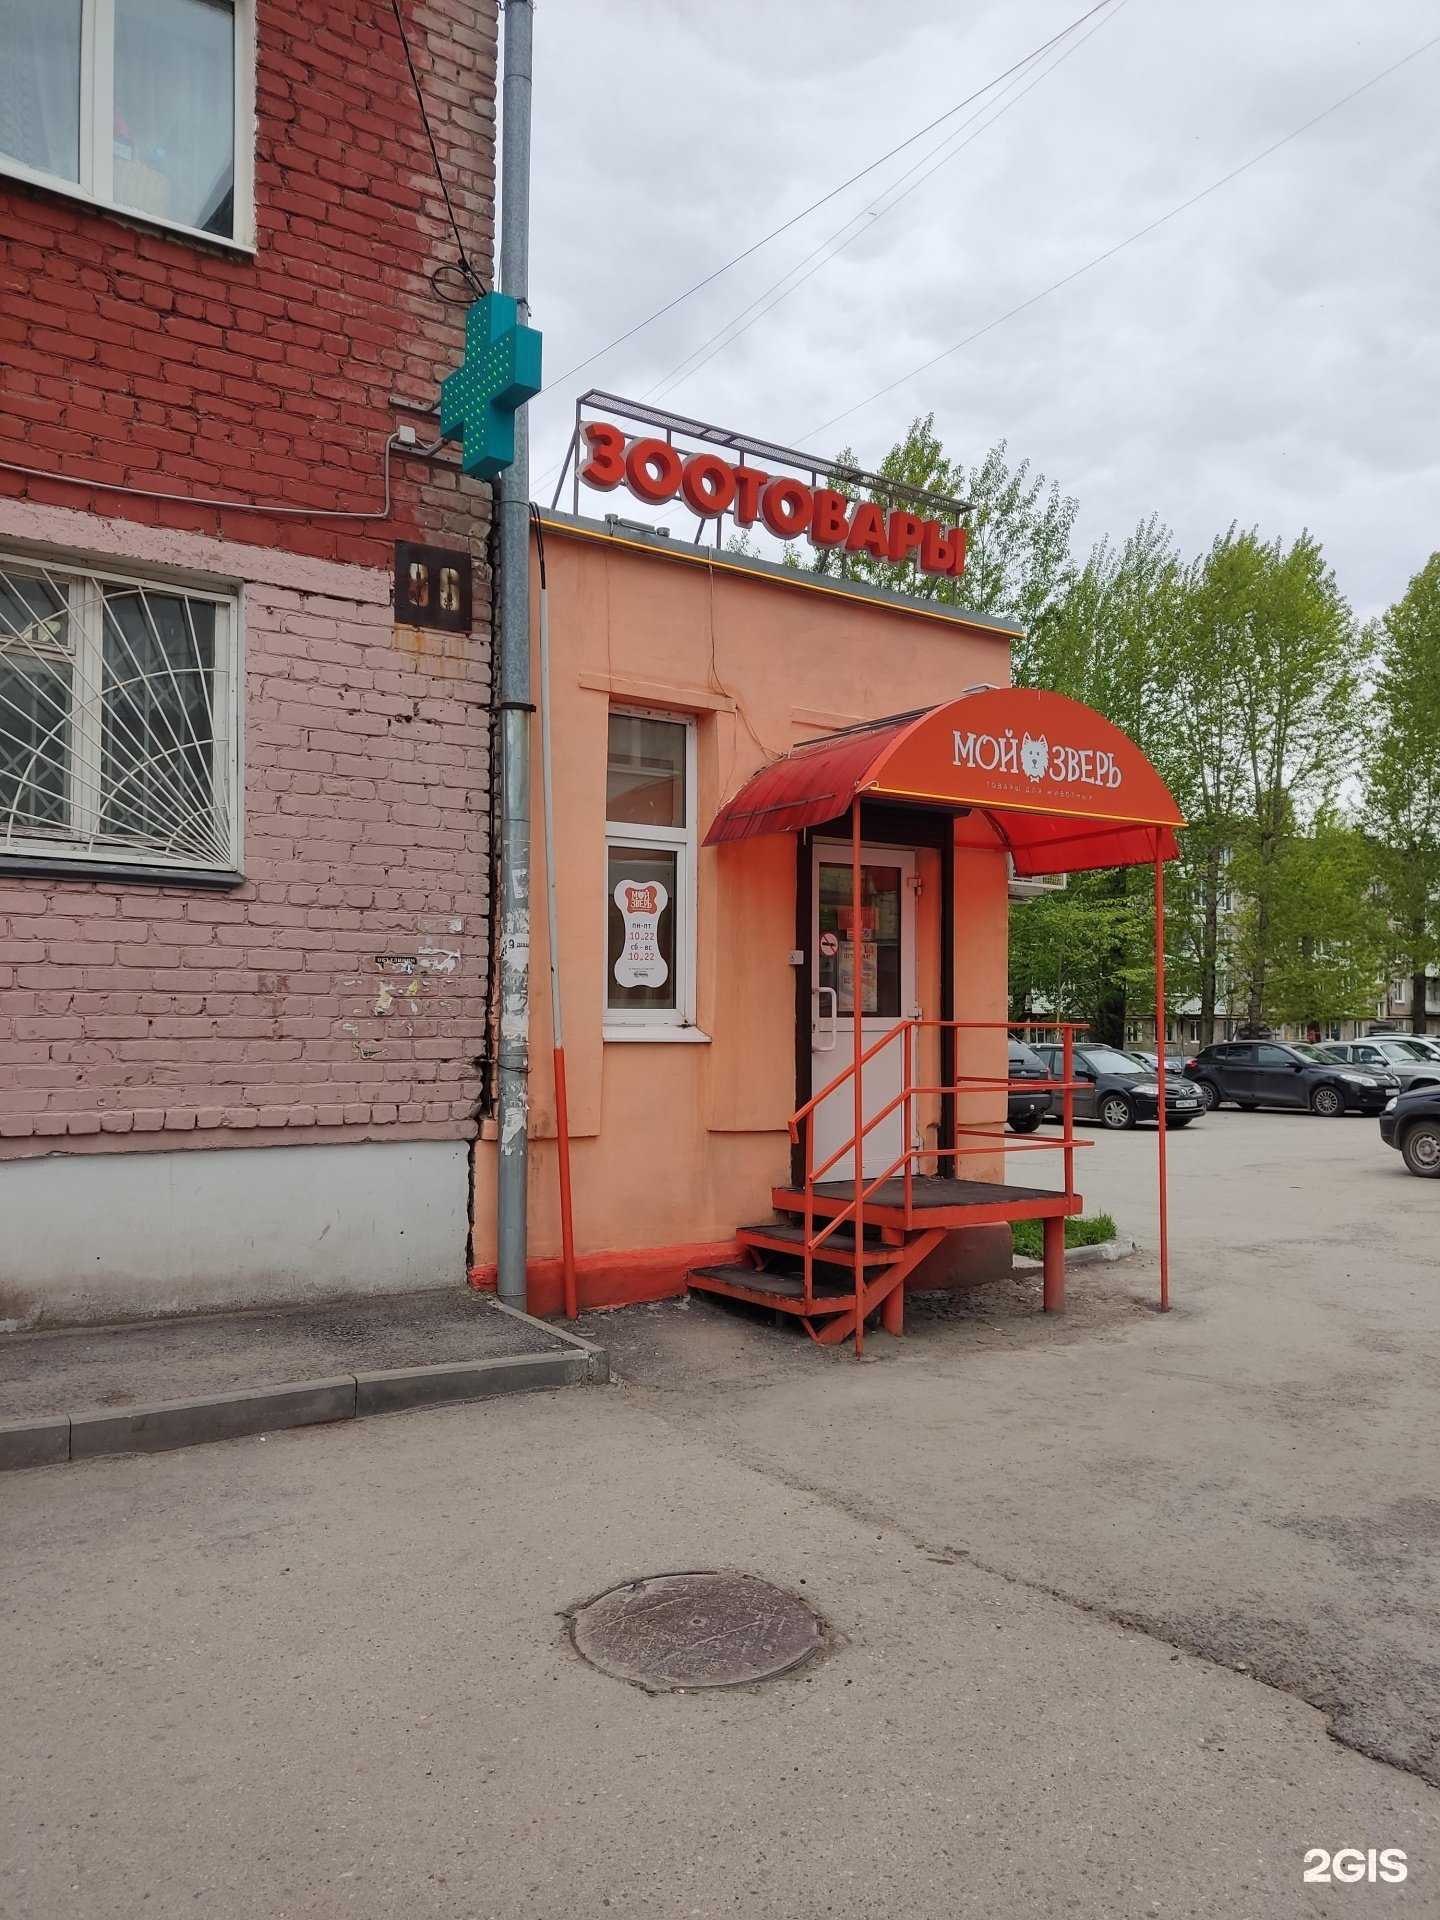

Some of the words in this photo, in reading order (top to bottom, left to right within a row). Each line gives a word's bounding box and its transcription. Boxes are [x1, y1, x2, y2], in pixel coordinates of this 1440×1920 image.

[576, 420, 967, 578] ЗООТОВАРЫ
[952, 728, 1019, 774] МОЙ
[1049, 745, 1123, 789] ЗВЕРЬ
